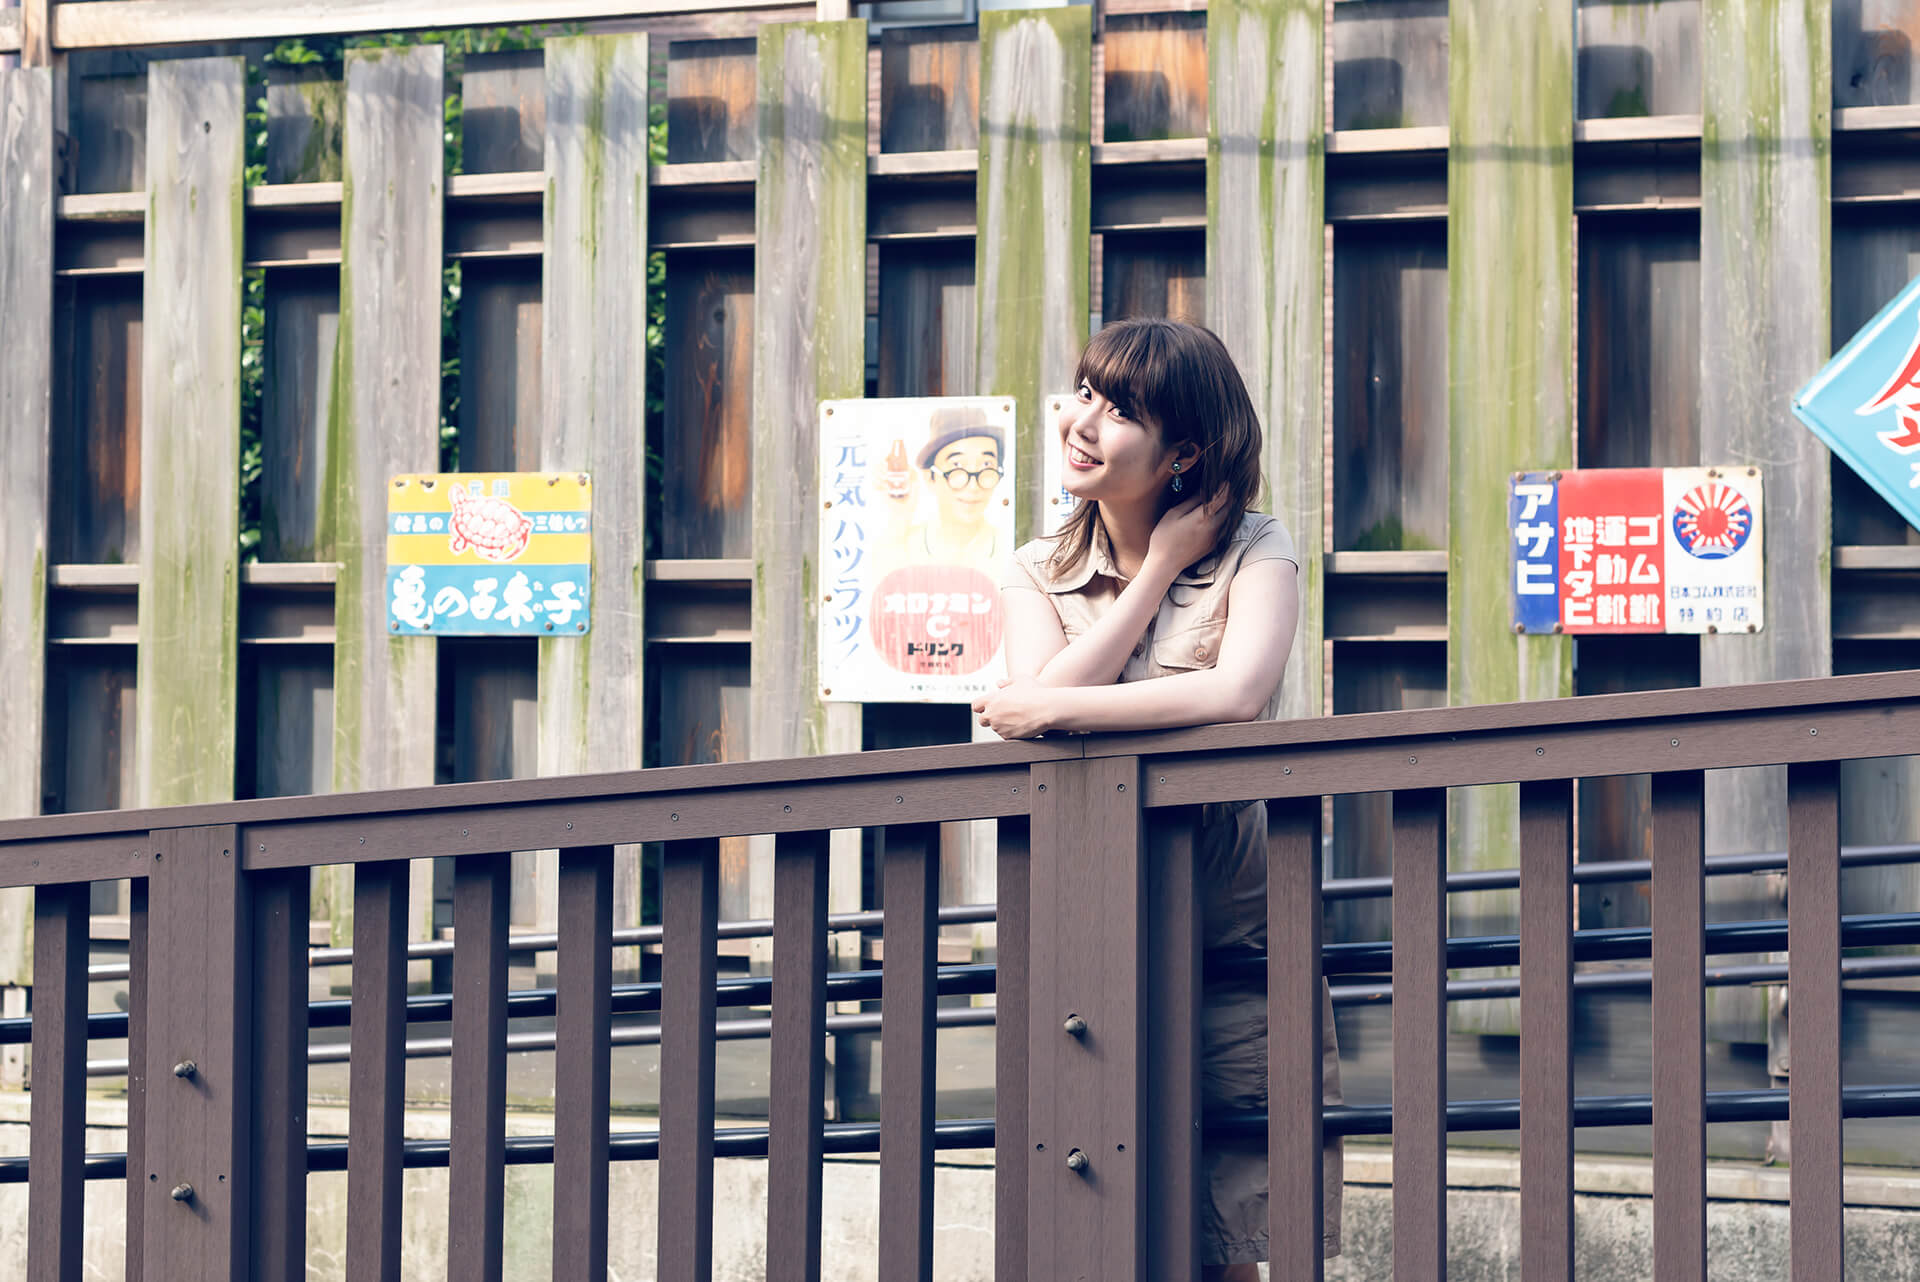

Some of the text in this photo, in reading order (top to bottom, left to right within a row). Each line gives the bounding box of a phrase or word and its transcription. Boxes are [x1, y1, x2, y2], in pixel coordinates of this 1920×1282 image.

[1515, 484, 1555, 595] アサヒ
[1563, 516, 1595, 626] 地下タビ
[1596, 516, 1627, 625] 運動靴
[1628, 514, 1661, 625] ゴム靴
[884, 592, 992, 614] オロナミン
[907, 642, 964, 656] ドリンク
[926, 615, 951, 638] C
